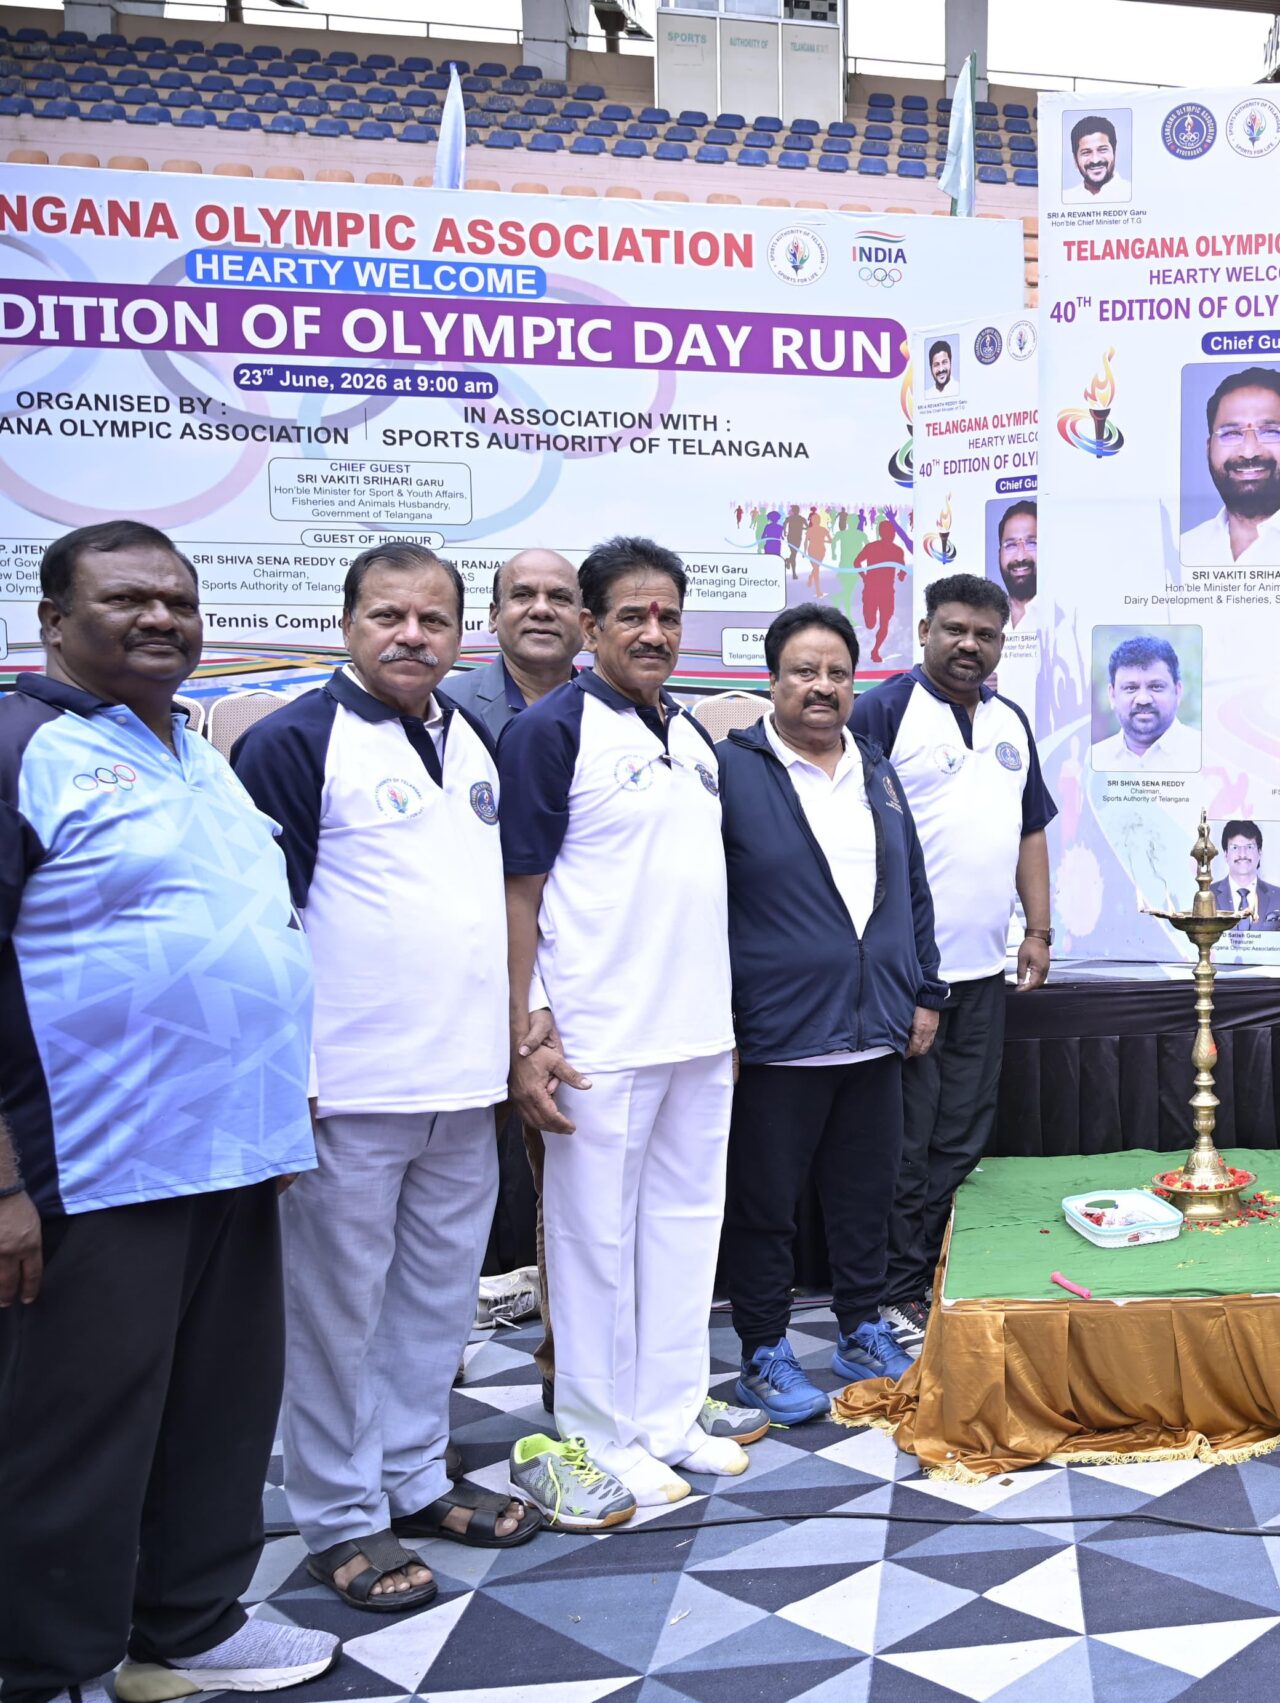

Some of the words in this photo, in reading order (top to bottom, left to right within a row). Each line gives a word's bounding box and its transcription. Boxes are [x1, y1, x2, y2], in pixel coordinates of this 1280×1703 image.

[667, 31, 707, 44] SPORTS
[1096, 218, 1121, 226] Minister
[195, 204, 416, 252] OLYMPIC
[432, 217, 753, 268] ASSOCIATION
[852, 246, 907, 264] INDIA
[1063, 236, 1188, 262] TELANGANA
[195, 252, 344, 288] HEARTY
[353, 261, 537, 296] WELCOME
[1148, 266, 1222, 286] HEARTY
[1049, 295, 1092, 324] 40TH
[1098, 297, 1191, 322] EDITION
[1198, 296, 1228, 320] OF
[0, 292, 219, 347] DITION
[241, 303, 321, 349] OF
[341, 307, 613, 363] OLYMPIC
[633, 320, 754, 367] DAY
[771, 327, 892, 374] RUN
[1210, 334, 1254, 352] Chief
[238, 366, 274, 386] 23rd
[279, 370, 334, 391] June,
[340, 372, 387, 391] 2026
[393, 375, 412, 391] at
[417, 375, 458, 393] 9:00
[464, 380, 494, 394] am
[16, 390, 170, 414] ORGANISED
[179, 396, 212, 414] BY
[464, 406, 487, 424] IN
[493, 408, 655, 430] ASSOCIATION
[659, 413, 718, 432] WITH
[925, 415, 988, 438] TELANGANA
[992, 409, 1038, 430] OLYMPIC
[59, 418, 173, 440] OLYMPIC
[179, 422, 349, 446] ASSOCIATION
[382, 429, 480, 449] SPORTS
[486, 432, 624, 453] AUTHORITY
[630, 437, 660, 454] OF
[669, 439, 810, 460] TELANGANA
[968, 434, 1005, 450] HEARTY
[330, 462, 366, 473] CHIEF
[369, 463, 411, 474] GUEST
[919, 458, 940, 478] 40TH
[943, 456, 990, 476] EDITION
[993, 453, 1009, 470] OF
[297, 473, 317, 484] SRI
[320, 474, 360, 485] VAKITI
[363, 475, 412, 487] SRIHARI
[415, 478, 444, 487] GARU
[1000, 478, 1022, 492] Chief
[313, 486, 351, 496] Minister
[353, 486, 366, 496] for
[368, 488, 394, 499] Sport
[396, 488, 404, 497] &
[406, 488, 433, 498] Youth
[435, 489, 467, 500] Affairs,
[291, 496, 335, 507] Fisheries
[338, 497, 355, 507] and
[357, 498, 395, 508] Animals
[398, 500, 451, 510] Husbandry,
[311, 508, 370, 519] Government
[372, 509, 383, 519] of
[384, 510, 433, 521] Telangana
[313, 533, 355, 545] GUEST
[358, 534, 375, 545] OF
[378, 535, 432, 547] HONOUR
[192, 554, 214, 565] SRI
[216, 555, 254, 566] SHIVA
[256, 556, 291, 567] SENA
[293, 557, 336, 567] REDDY
[253, 568, 310, 580] Chairman,
[722, 565, 748, 575] Garu
[1192, 570, 1210, 580] SRI
[1212, 570, 1247, 580] VAKITI
[201, 580, 238, 591] Sports
[240, 581, 289, 593] Authority
[291, 581, 302, 592] of
[687, 576, 736, 588] Managing
[739, 577, 781, 588] Director,
[1203, 582, 1241, 592] Minister
[1243, 582, 1257, 592] for
[696, 588, 747, 600] Telangana
[1124, 595, 1149, 606] Dairy
[1151, 595, 1214, 606] Development
[1216, 595, 1223, 604] &
[1226, 594, 1272, 605] Fisheries,
[205, 613, 269, 629] Tennis
[741, 633, 749, 642] D
[1123, 795, 1150, 803] Authority
[1158, 796, 1190, 804] Telangana
